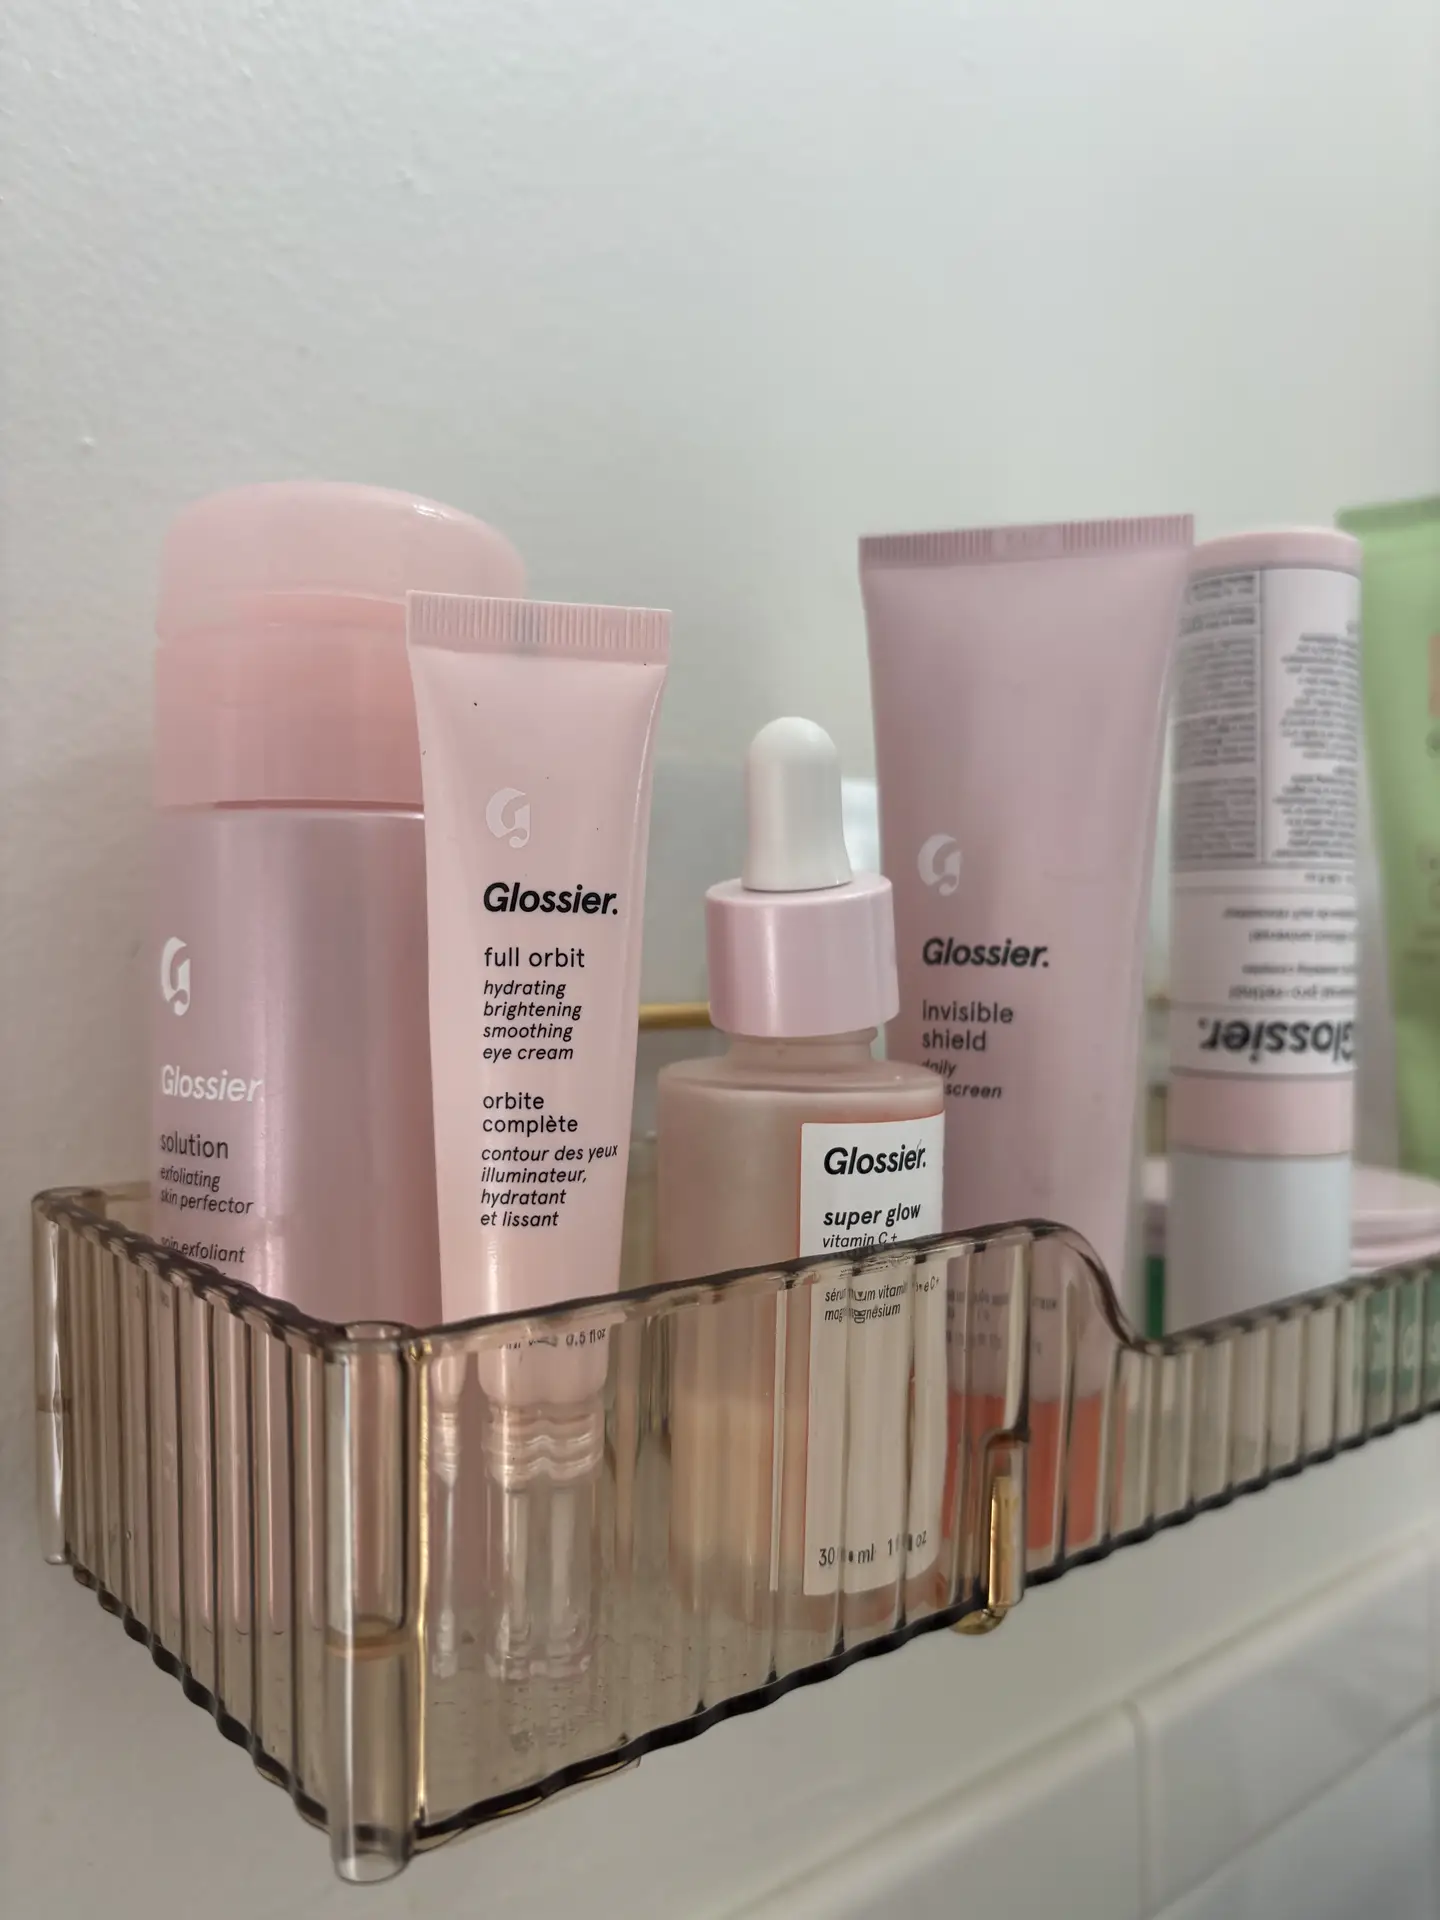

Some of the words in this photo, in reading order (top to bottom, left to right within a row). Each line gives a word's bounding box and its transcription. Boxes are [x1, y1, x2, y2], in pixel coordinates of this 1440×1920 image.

[483, 882, 618, 915] Glossier.
[484, 947, 520, 968] full
[528, 947, 586, 968] orbit
[922, 936, 1050, 968] Glossier.
[483, 980, 566, 1000] hydrating
[483, 1002, 582, 1021] brightening
[922, 999, 1014, 1024] invisible
[483, 1023, 573, 1042] smoothing
[921, 1028, 987, 1051] shield
[482, 1047, 512, 1064] eye
[517, 1047, 574, 1060] cream
[482, 1092, 545, 1110] orbite
[482, 1115, 579, 1138] complète
[160, 1130, 229, 1160] solution
[481, 1147, 549, 1162] contour
[554, 1145, 584, 1161] des
[587, 1144, 619, 1164] yeux
[823, 1143, 927, 1175] Glossier.
[160, 1164, 221, 1193] exfoliating
[481, 1167, 587, 1184] illuminateur,
[160, 1187, 178, 1206] skin
[180, 1192, 254, 1215] perfector
[480, 1188, 567, 1208] hydratant
[480, 1212, 498, 1226] et
[502, 1211, 559, 1227] lissant
[823, 1208, 882, 1230] super
[885, 1202, 921, 1228] glow
[822, 1233, 875, 1248] vitamin
[181, 1241, 247, 1263] exfoliant
